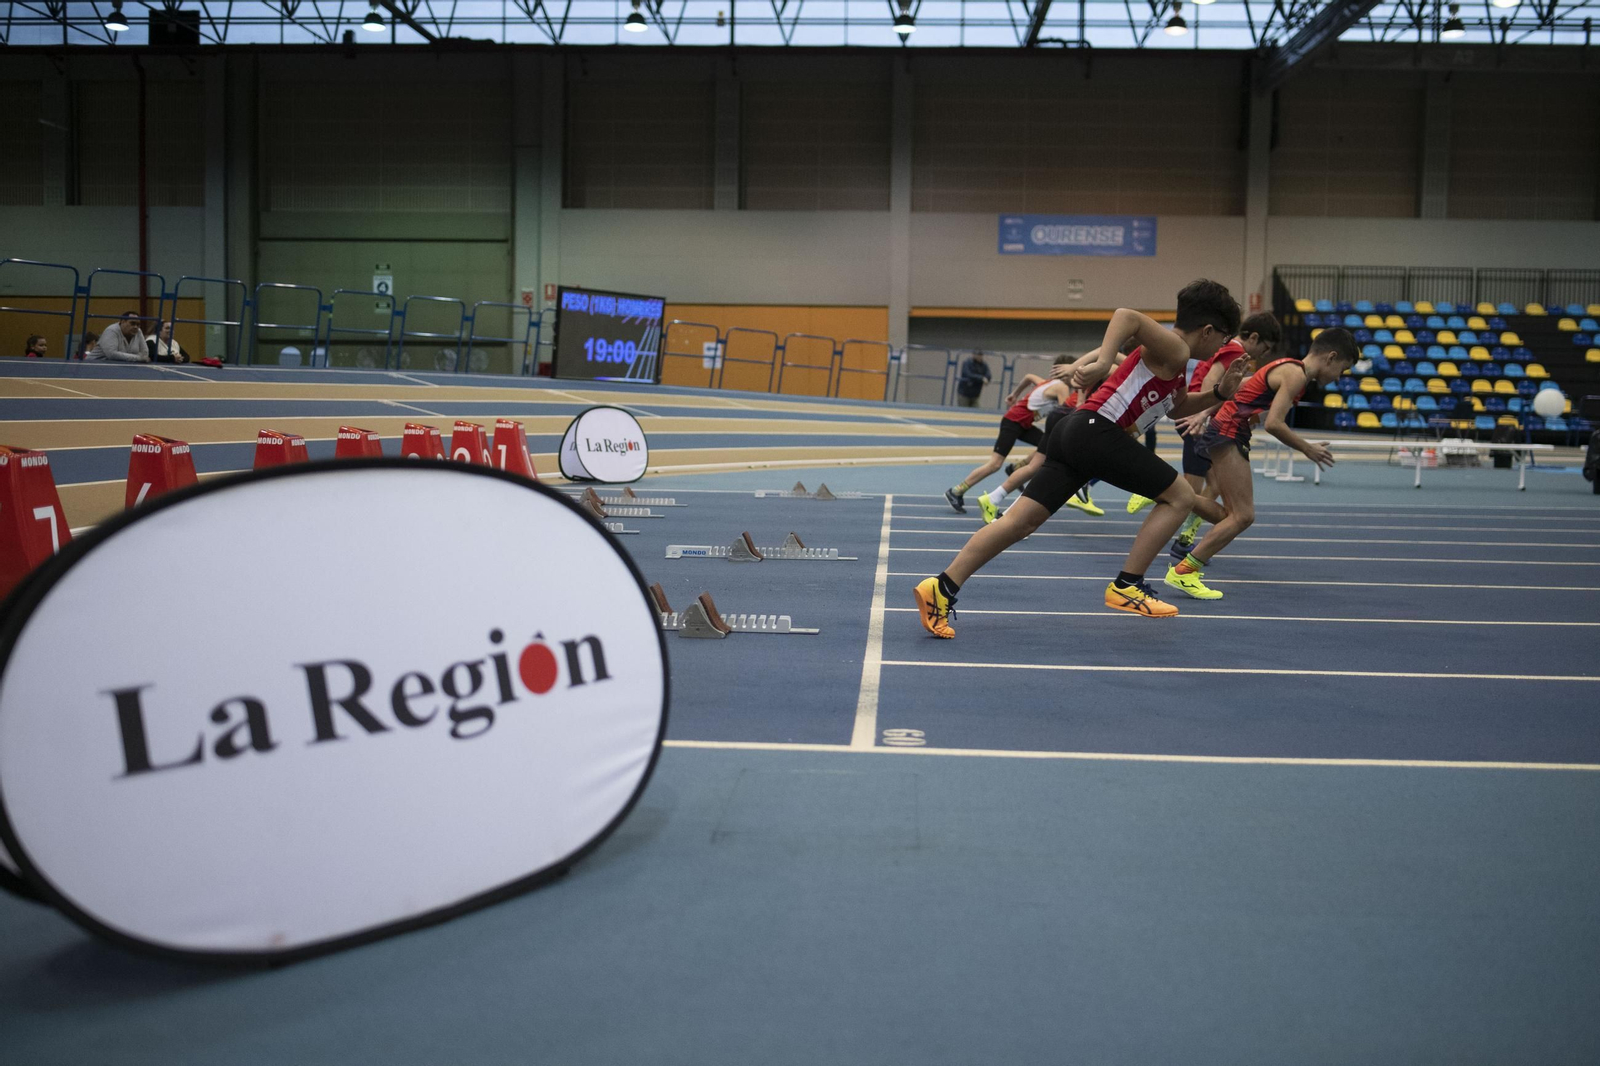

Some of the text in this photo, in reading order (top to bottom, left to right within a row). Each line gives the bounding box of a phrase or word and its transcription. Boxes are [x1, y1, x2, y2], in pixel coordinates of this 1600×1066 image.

[1031, 225, 1124, 246] OURENSE
[562, 292, 589, 312] PESO
[584, 337, 636, 364] 19:00
[257, 437, 283, 446] MONDO
[338, 432, 361, 440] MONDO
[131, 444, 162, 454] MONDO
[171, 445, 190, 455] MONDO
[586, 438, 603, 453] La
[21, 455, 48, 468] MONDO
[33, 505, 60, 555] 7
[98, 627, 614, 783] La Región
